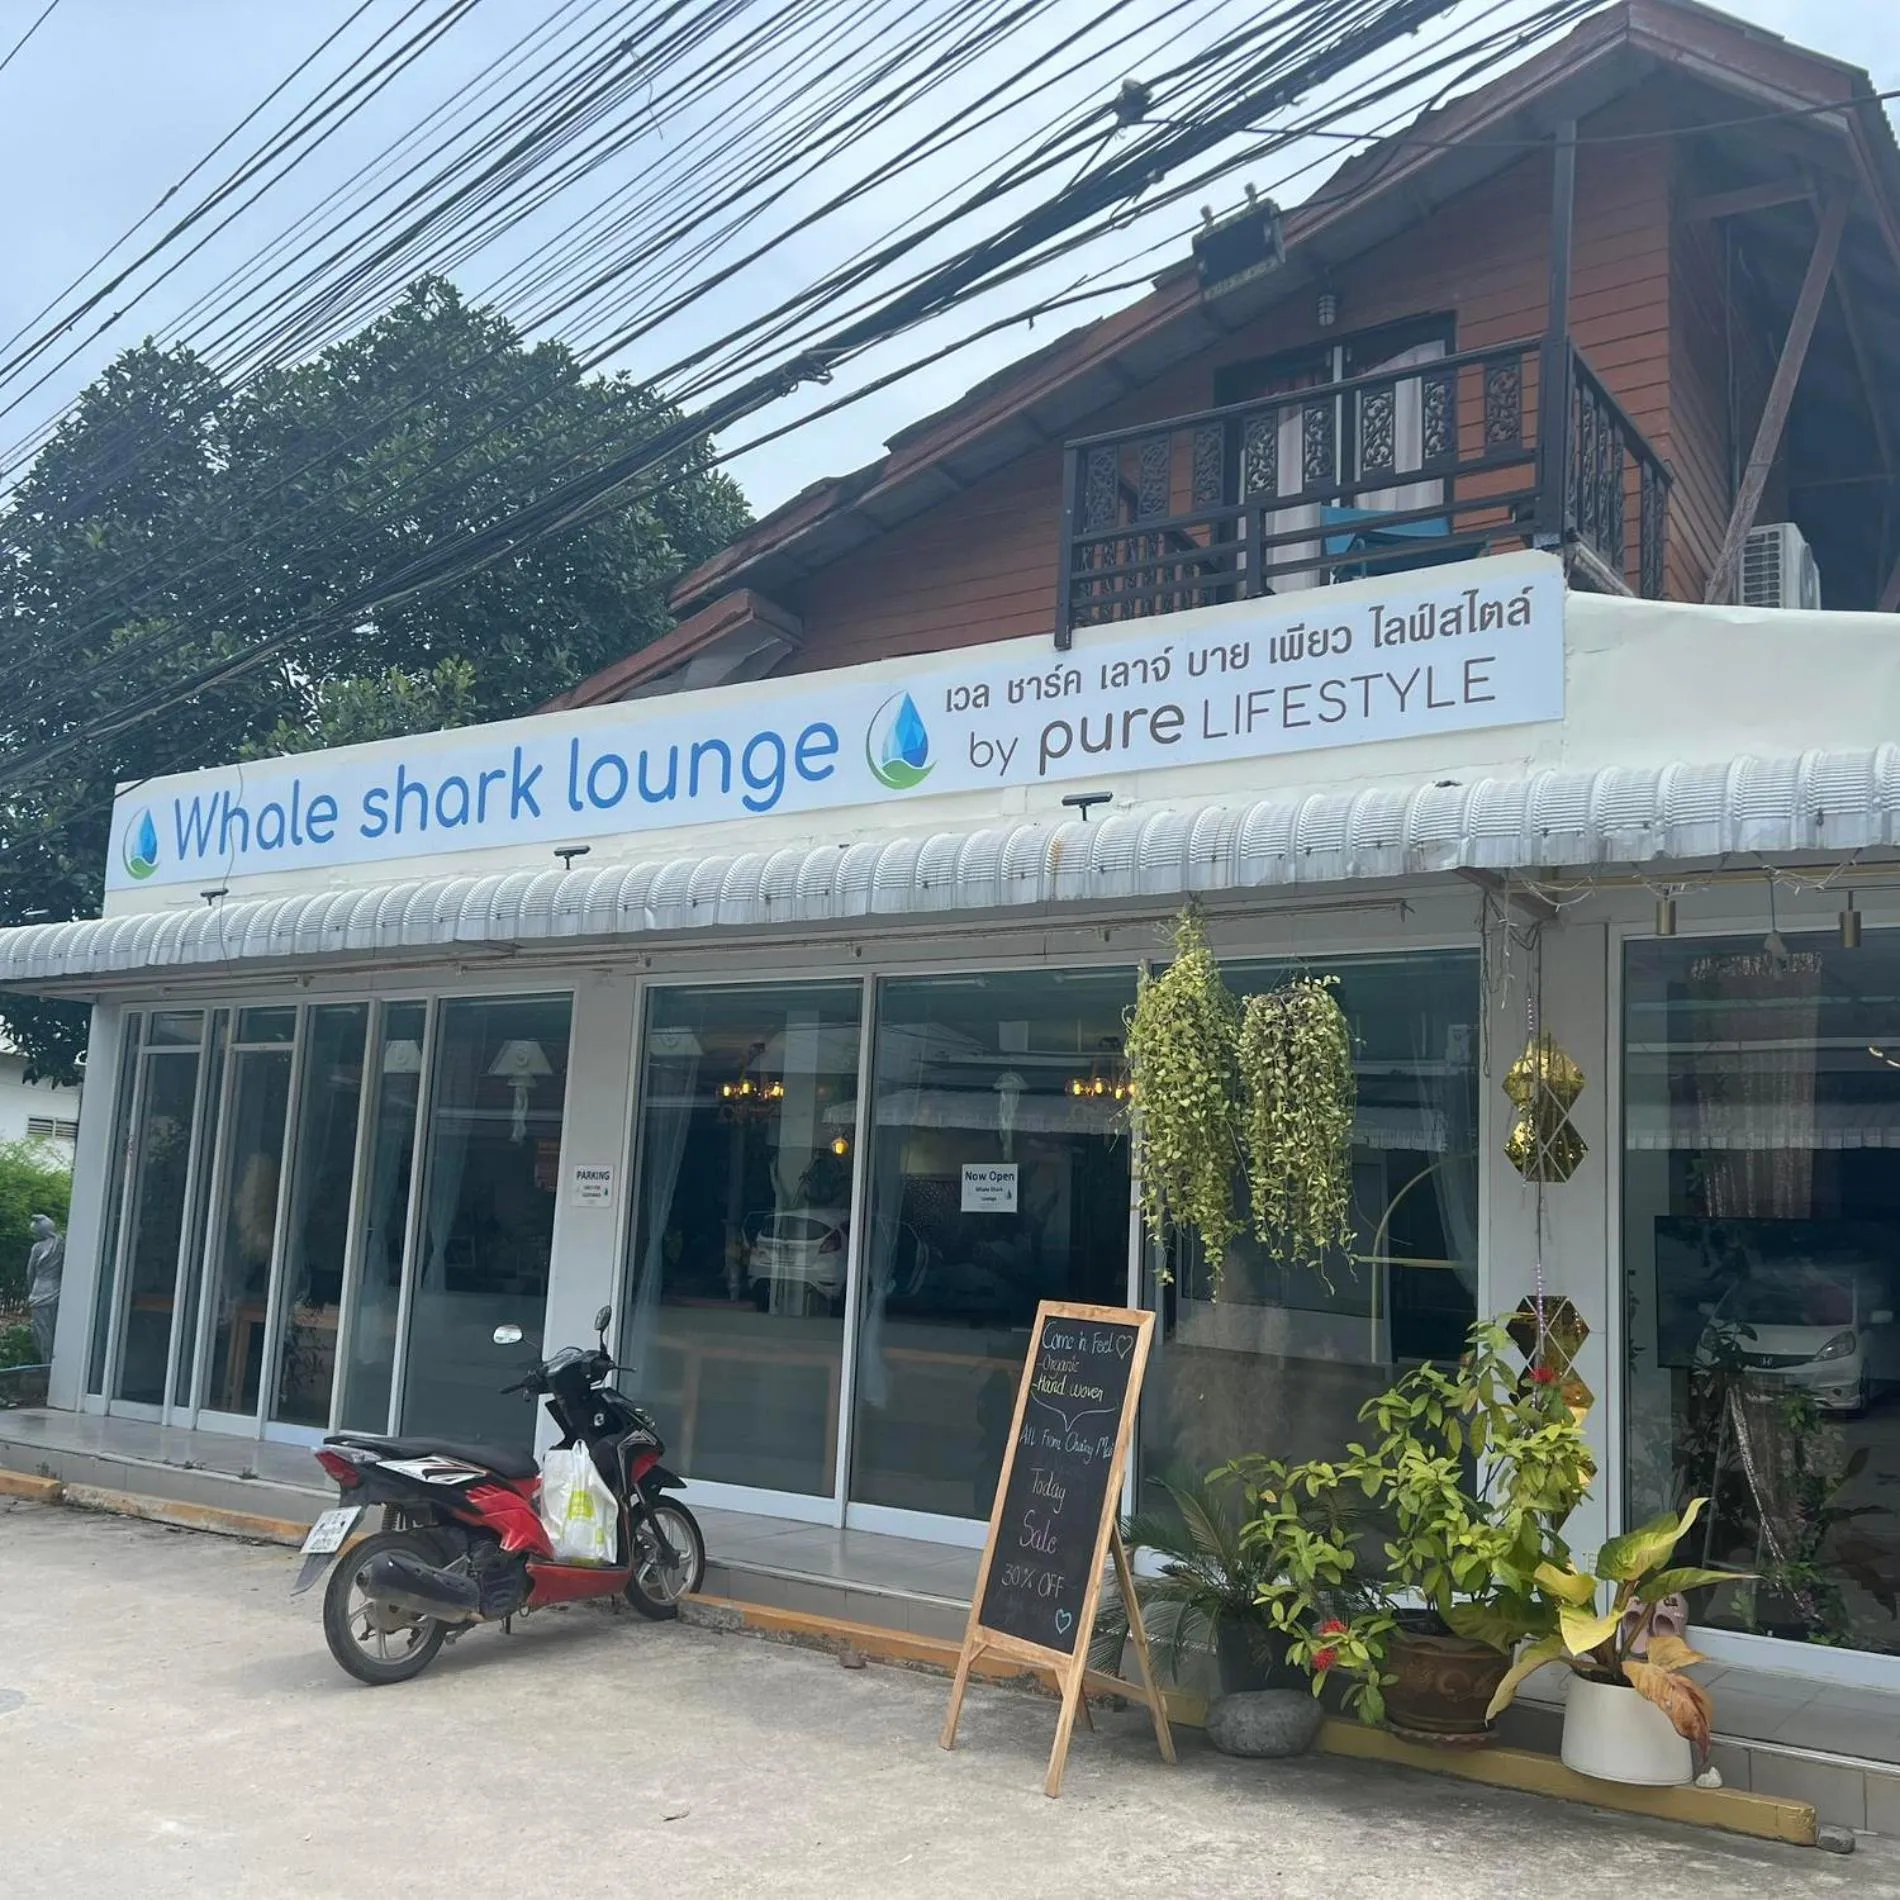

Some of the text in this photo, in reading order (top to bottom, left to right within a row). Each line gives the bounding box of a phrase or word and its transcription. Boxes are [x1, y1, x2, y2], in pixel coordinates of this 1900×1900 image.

[946, 585, 1533, 713] เวล ชาร์ค เลาจ์ บาย เพียว ไลฟ์สไตล์
[968, 656, 1497, 777] by pure LIFESTYLE
[174, 721, 840, 861] Whale shark lounge
[576, 1170, 610, 1180] PARKING
[965, 1171, 1014, 1182] Now Open
[1042, 1320, 1074, 1351] Come
[1078, 1330, 1087, 1351] in
[1030, 1467, 1067, 1515] Today
[1019, 1508, 1058, 1554] Sale
[1001, 1563, 1065, 1599] 30% OFF
